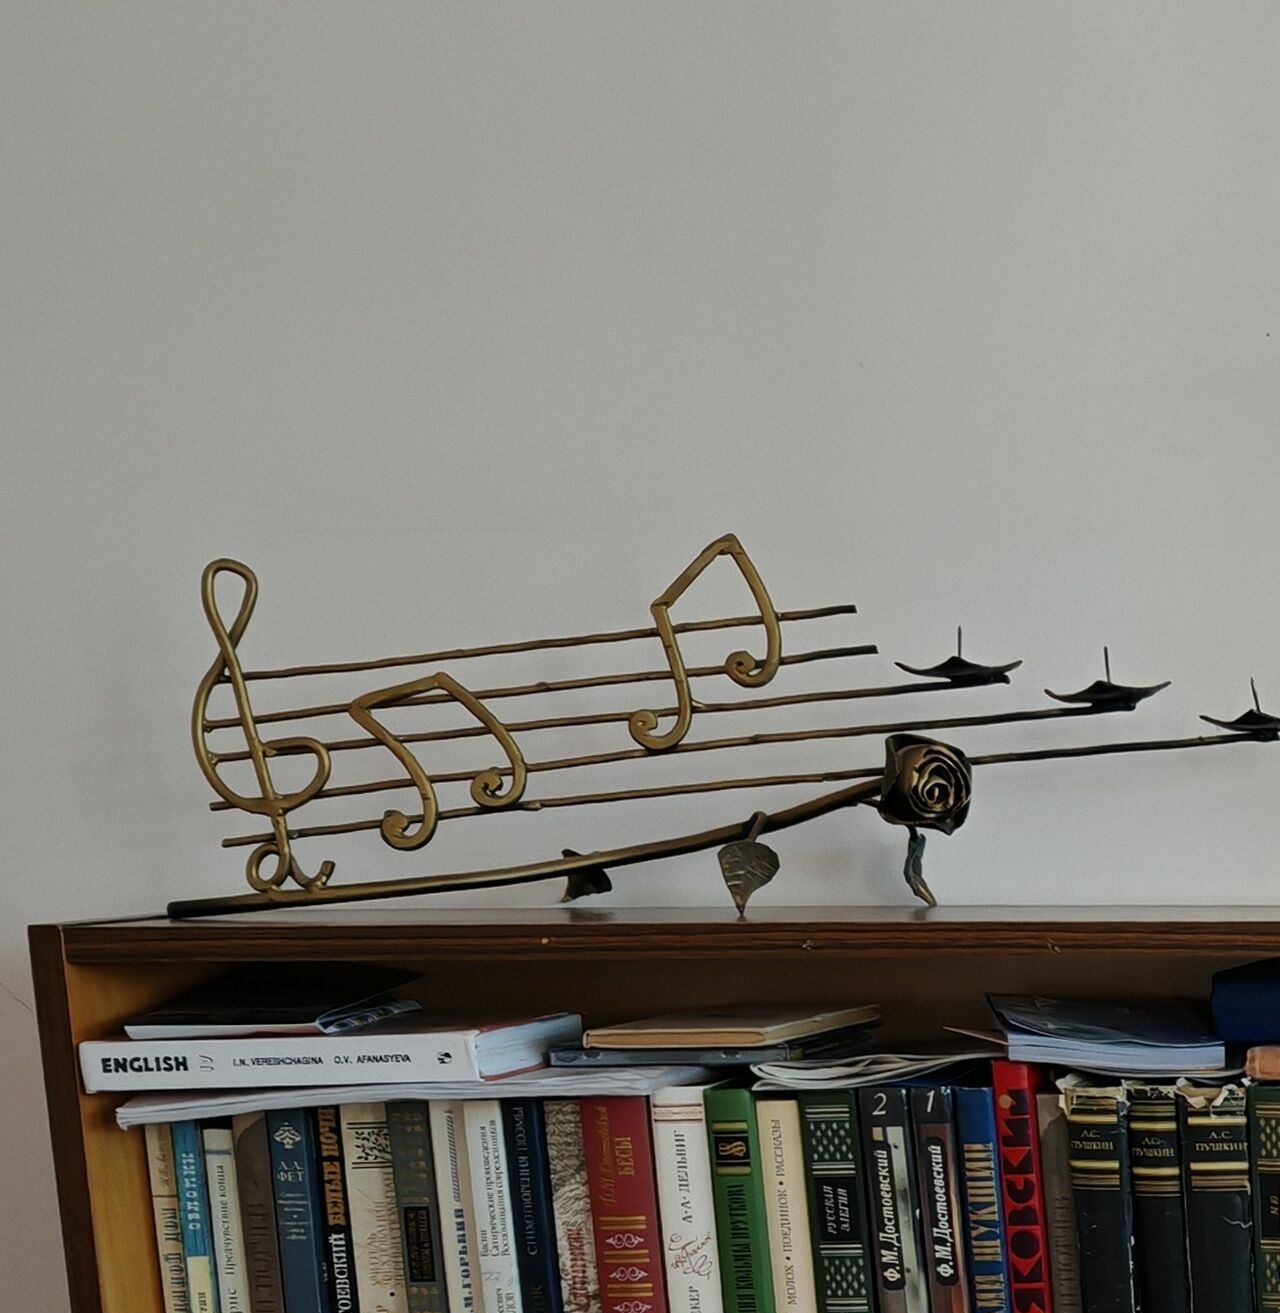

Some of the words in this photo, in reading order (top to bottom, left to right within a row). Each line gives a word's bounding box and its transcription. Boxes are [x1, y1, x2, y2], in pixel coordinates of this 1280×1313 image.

[101, 1055, 189, 1074] ENGLISH
[871, 1094, 888, 1115] 2
[924, 1089, 937, 1113] 1
[614, 1136, 634, 1177] БЕСЫ
[770, 1119, 786, 1177] РАССКАЗЫ
[215, 1164, 229, 1199] конца
[963, 1142, 1003, 1262] ШУКШИН
[776, 1189, 793, 1253] ПОЕДИНОК
[823, 1185, 837, 1234] РУССКАЯ
[873, 1149, 902, 1282] Ф.М.Достоевский
[928, 1145, 955, 1278] Ф.М.Достоевский
[218, 1201, 237, 1275] Предчувствие
[784, 1264, 797, 1306] МОЛОХ
